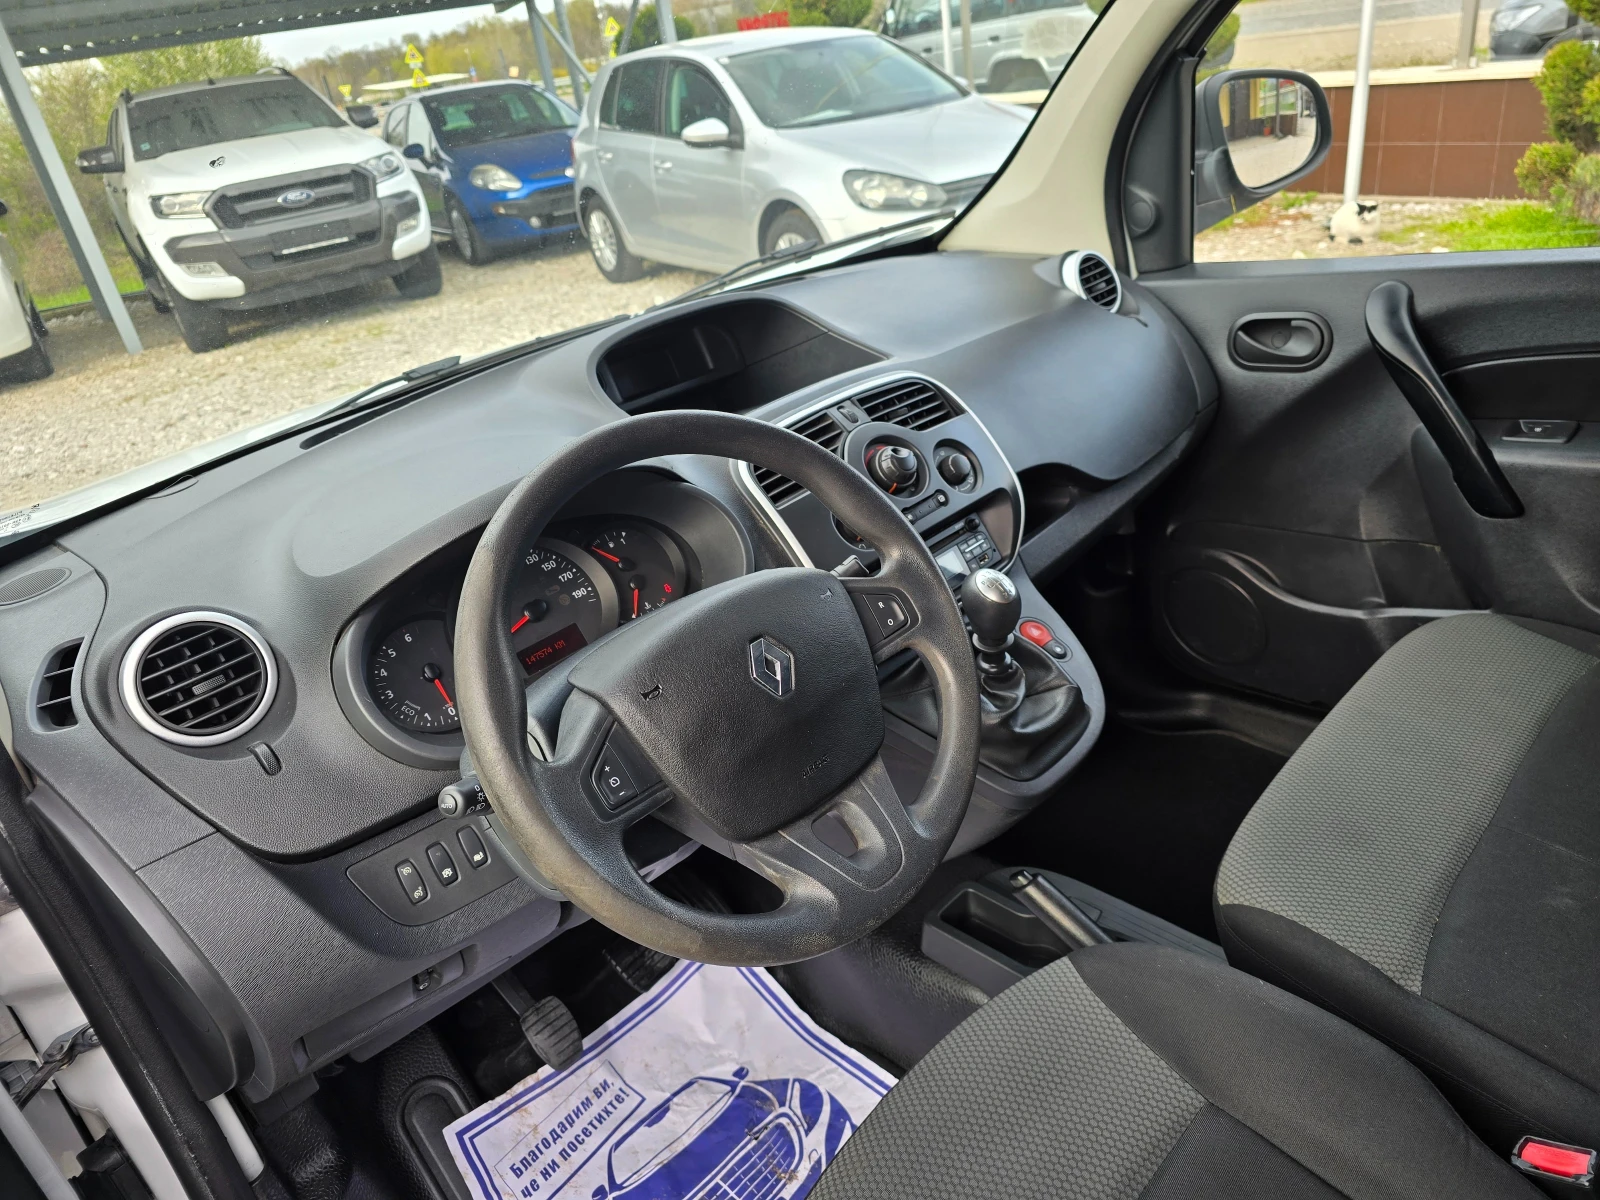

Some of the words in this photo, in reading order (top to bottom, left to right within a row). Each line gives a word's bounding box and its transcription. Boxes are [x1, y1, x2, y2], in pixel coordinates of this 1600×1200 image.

[525, 553, 539, 565] 130
[541, 560, 556, 572] 150
[558, 571, 573, 583] 170
[572, 587, 587, 599] 190
[878, 601, 885, 609] R
[404, 633, 412, 642] 6
[388, 648, 396, 657] 5
[526, 647, 552, 665] 147574
[554, 640, 566, 650] KM
[380, 668, 388, 677] 4
[385, 690, 394, 699] 3
[401, 705, 415, 716] ECO
[447, 707, 456, 716] 0
[424, 712, 432, 721] 1
[508, 1096, 594, 1180] Благодарим
[592, 1078, 615, 1100] ви,
[520, 1178, 540, 1199] че
[539, 1158, 561, 1182] ни
[558, 1087, 630, 1162] посетихте!
